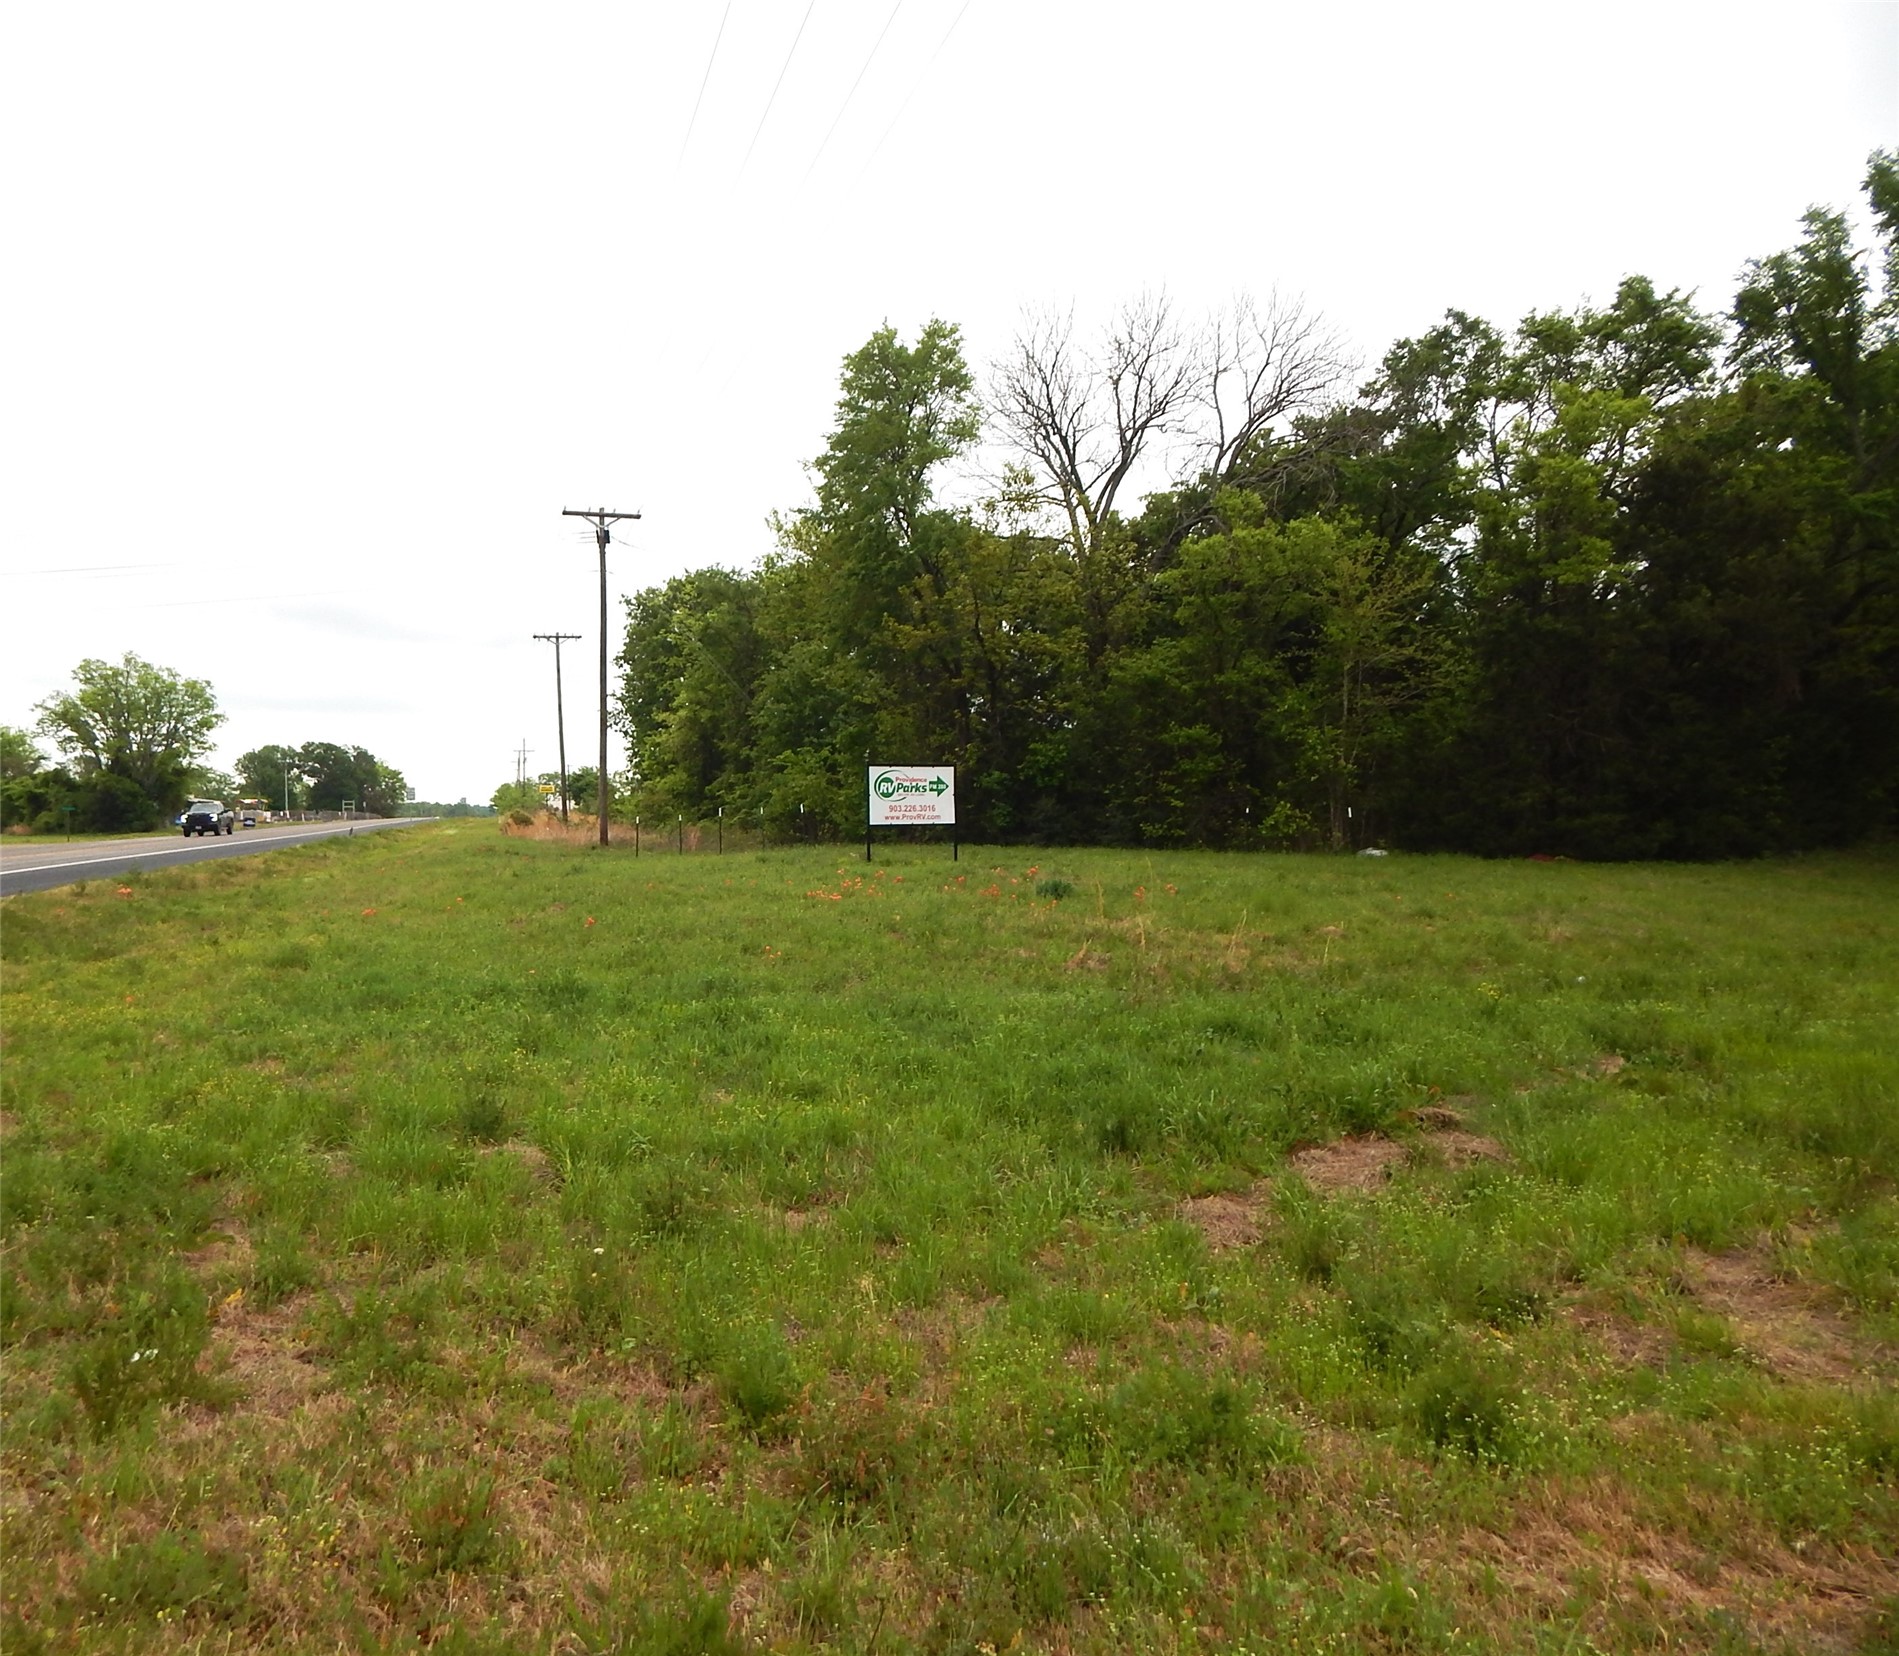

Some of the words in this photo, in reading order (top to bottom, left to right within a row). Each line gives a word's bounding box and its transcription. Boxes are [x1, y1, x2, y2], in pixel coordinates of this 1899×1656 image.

[879, 782, 895, 794] RV
[896, 783, 927, 793] Parks
[888, 804, 936, 812] 903.226.3016
